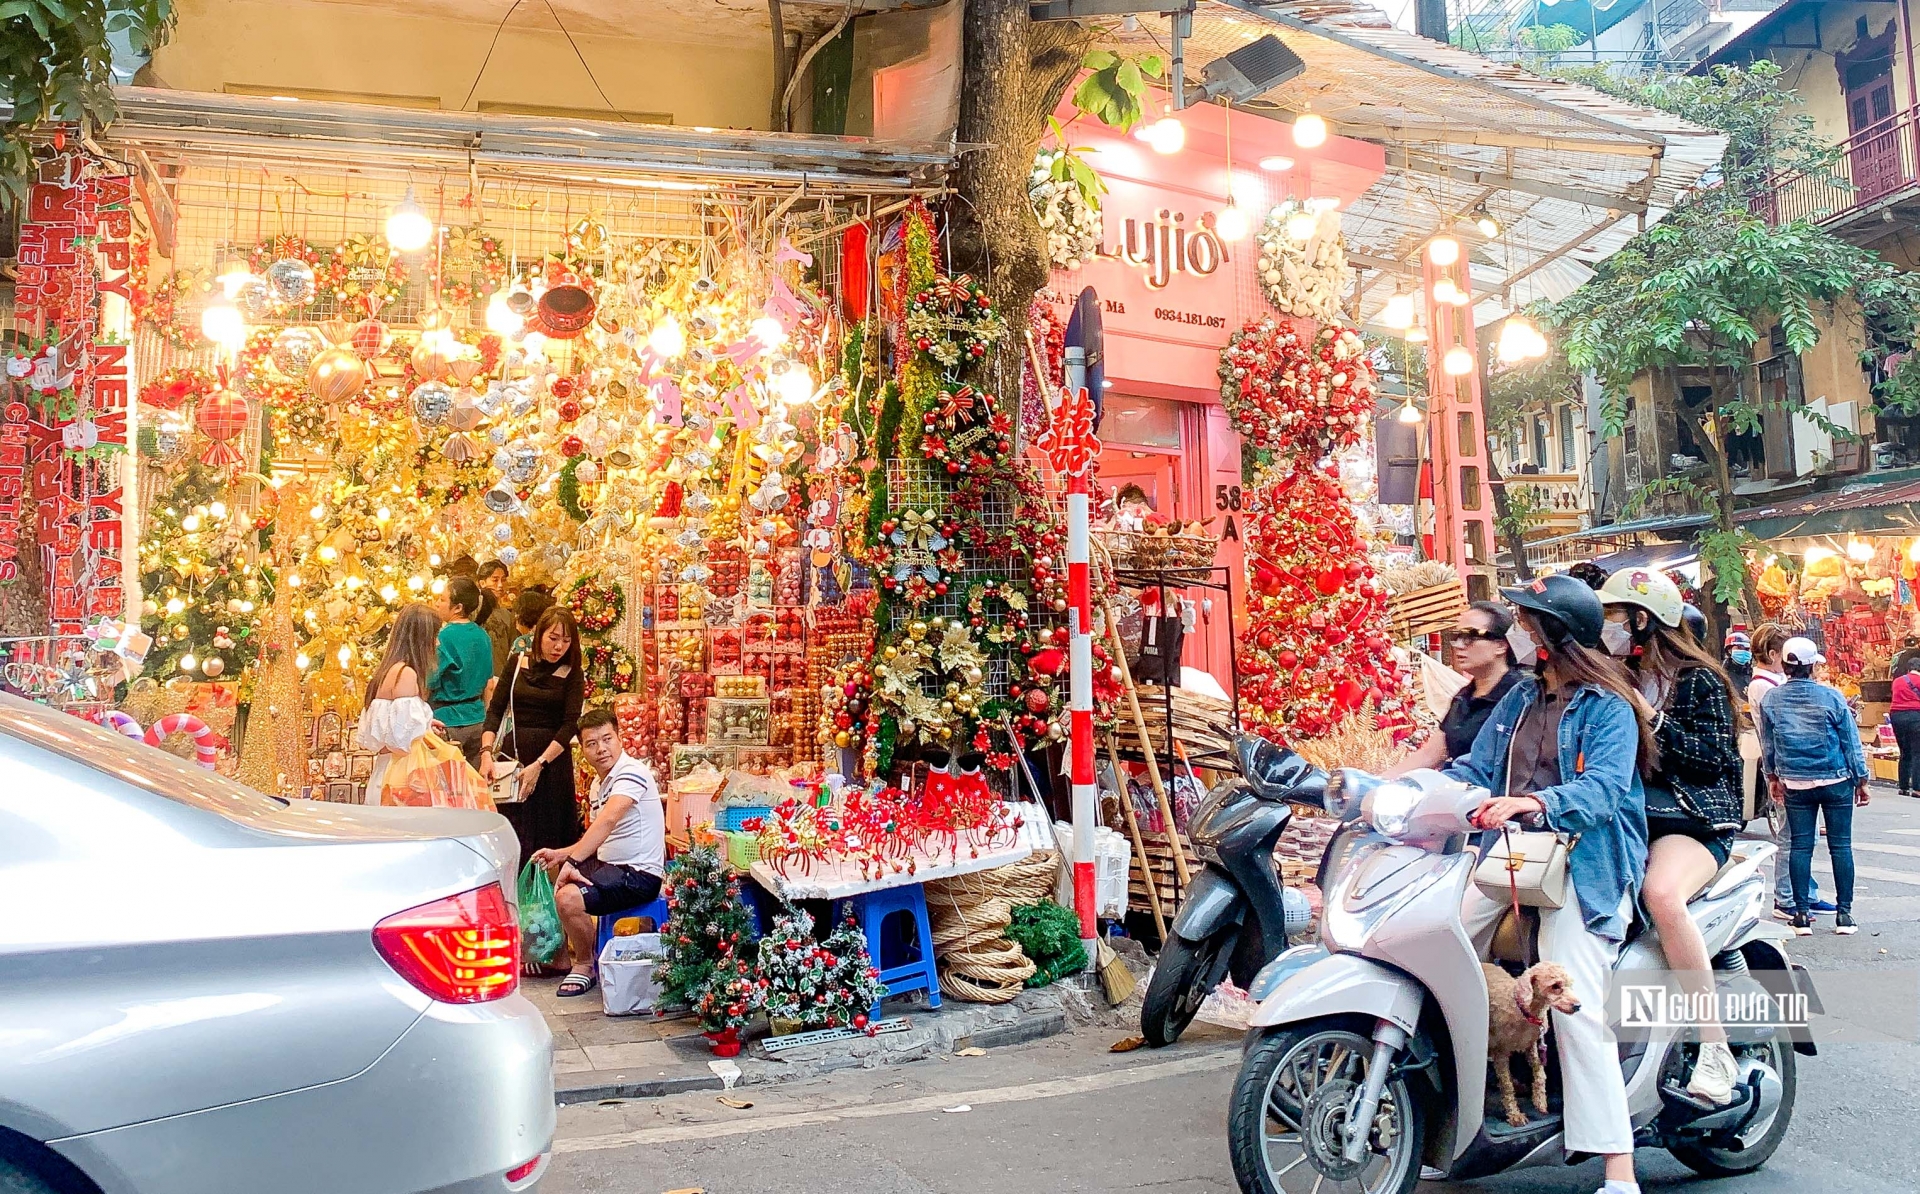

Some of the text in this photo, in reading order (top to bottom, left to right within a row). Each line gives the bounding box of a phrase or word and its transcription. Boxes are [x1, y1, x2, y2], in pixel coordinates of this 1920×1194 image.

[1105, 300, 1126, 314] Mã
[1154, 307, 1227, 329] 0934.181.087
[0, 223, 46, 582] MERRY CHRISTMAS
[89, 175, 131, 618] APPY NEW YEAR
[1215, 484, 1242, 512] 58
[1221, 514, 1239, 543] A
